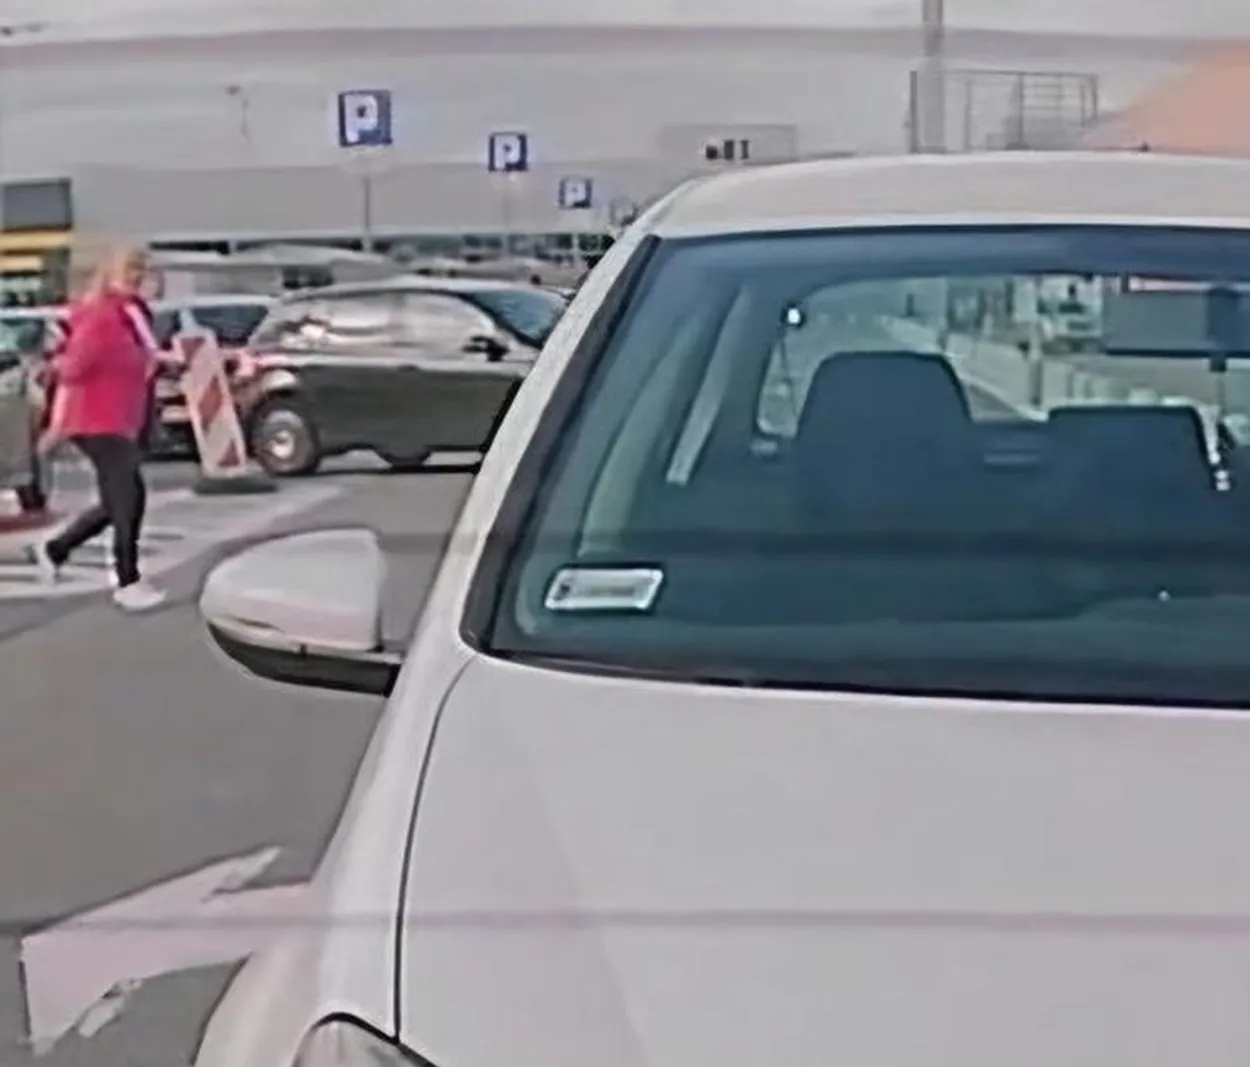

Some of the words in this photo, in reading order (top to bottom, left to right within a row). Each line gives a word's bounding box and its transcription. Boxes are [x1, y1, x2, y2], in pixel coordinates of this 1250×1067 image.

[344, 94, 379, 143] P
[494, 134, 522, 169] P
[564, 179, 586, 206] P
